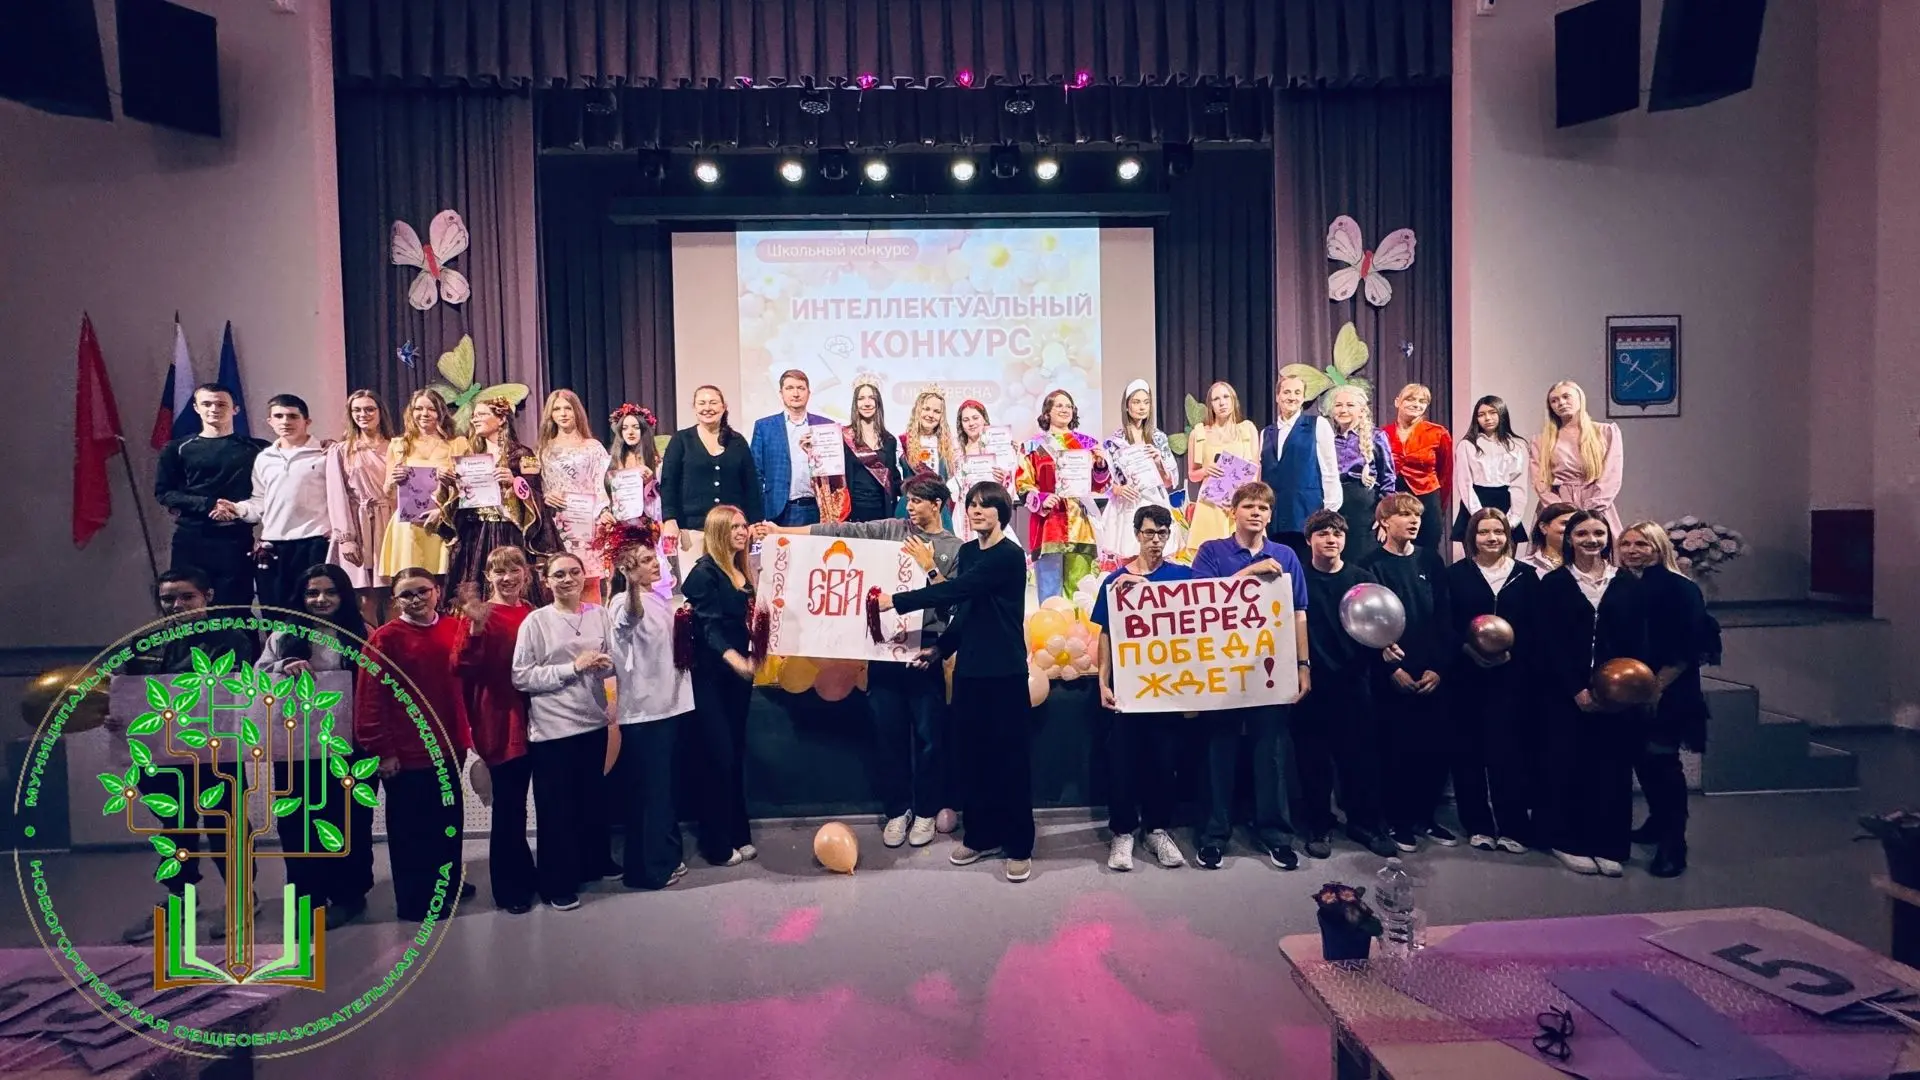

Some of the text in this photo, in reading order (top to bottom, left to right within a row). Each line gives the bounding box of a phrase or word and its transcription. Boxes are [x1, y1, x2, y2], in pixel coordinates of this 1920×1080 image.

[767, 243, 910, 259] Школьный конкурс
[791, 293, 1093, 321] ИНТЕЛЛЕКТУАЛЬНЫЙ
[860, 328, 1033, 359] КОНКУРС
[1115, 578, 1262, 612] КАМПУС
[1118, 629, 1276, 668] ПОБЕДА
[1712, 943, 1856, 997] 5
